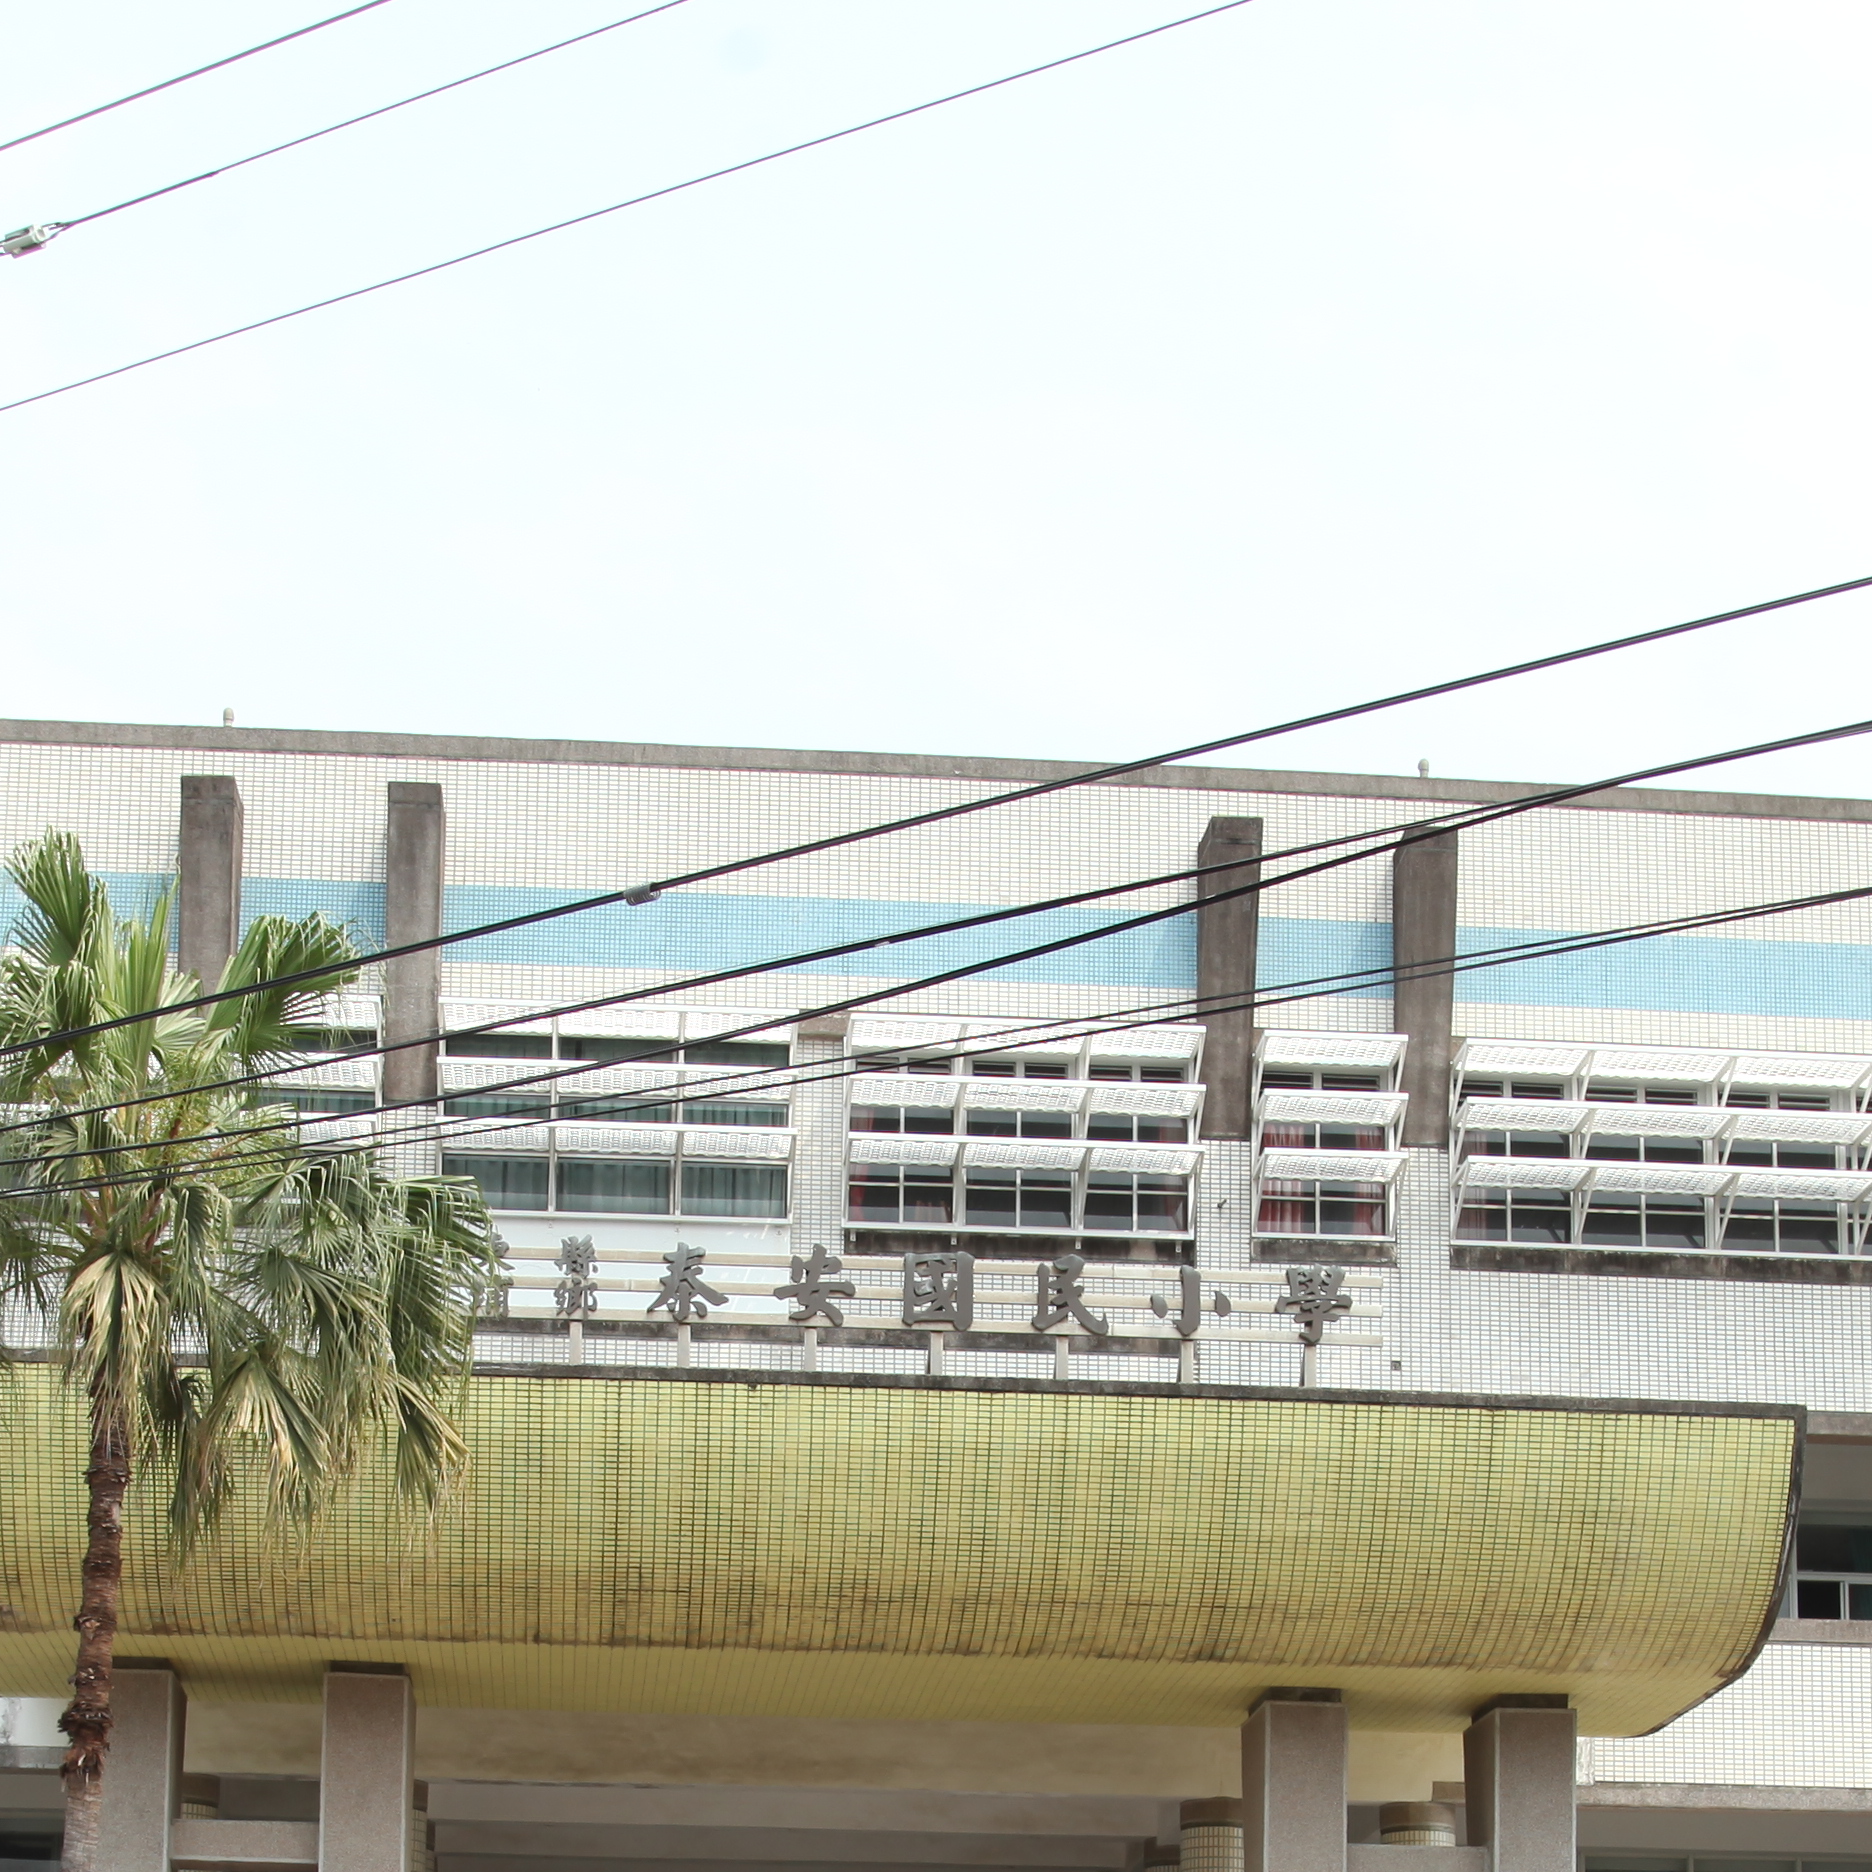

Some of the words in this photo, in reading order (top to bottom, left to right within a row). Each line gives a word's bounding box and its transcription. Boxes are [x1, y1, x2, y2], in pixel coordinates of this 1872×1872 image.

[647, 1241, 1353, 1346] 泰安國民小學
